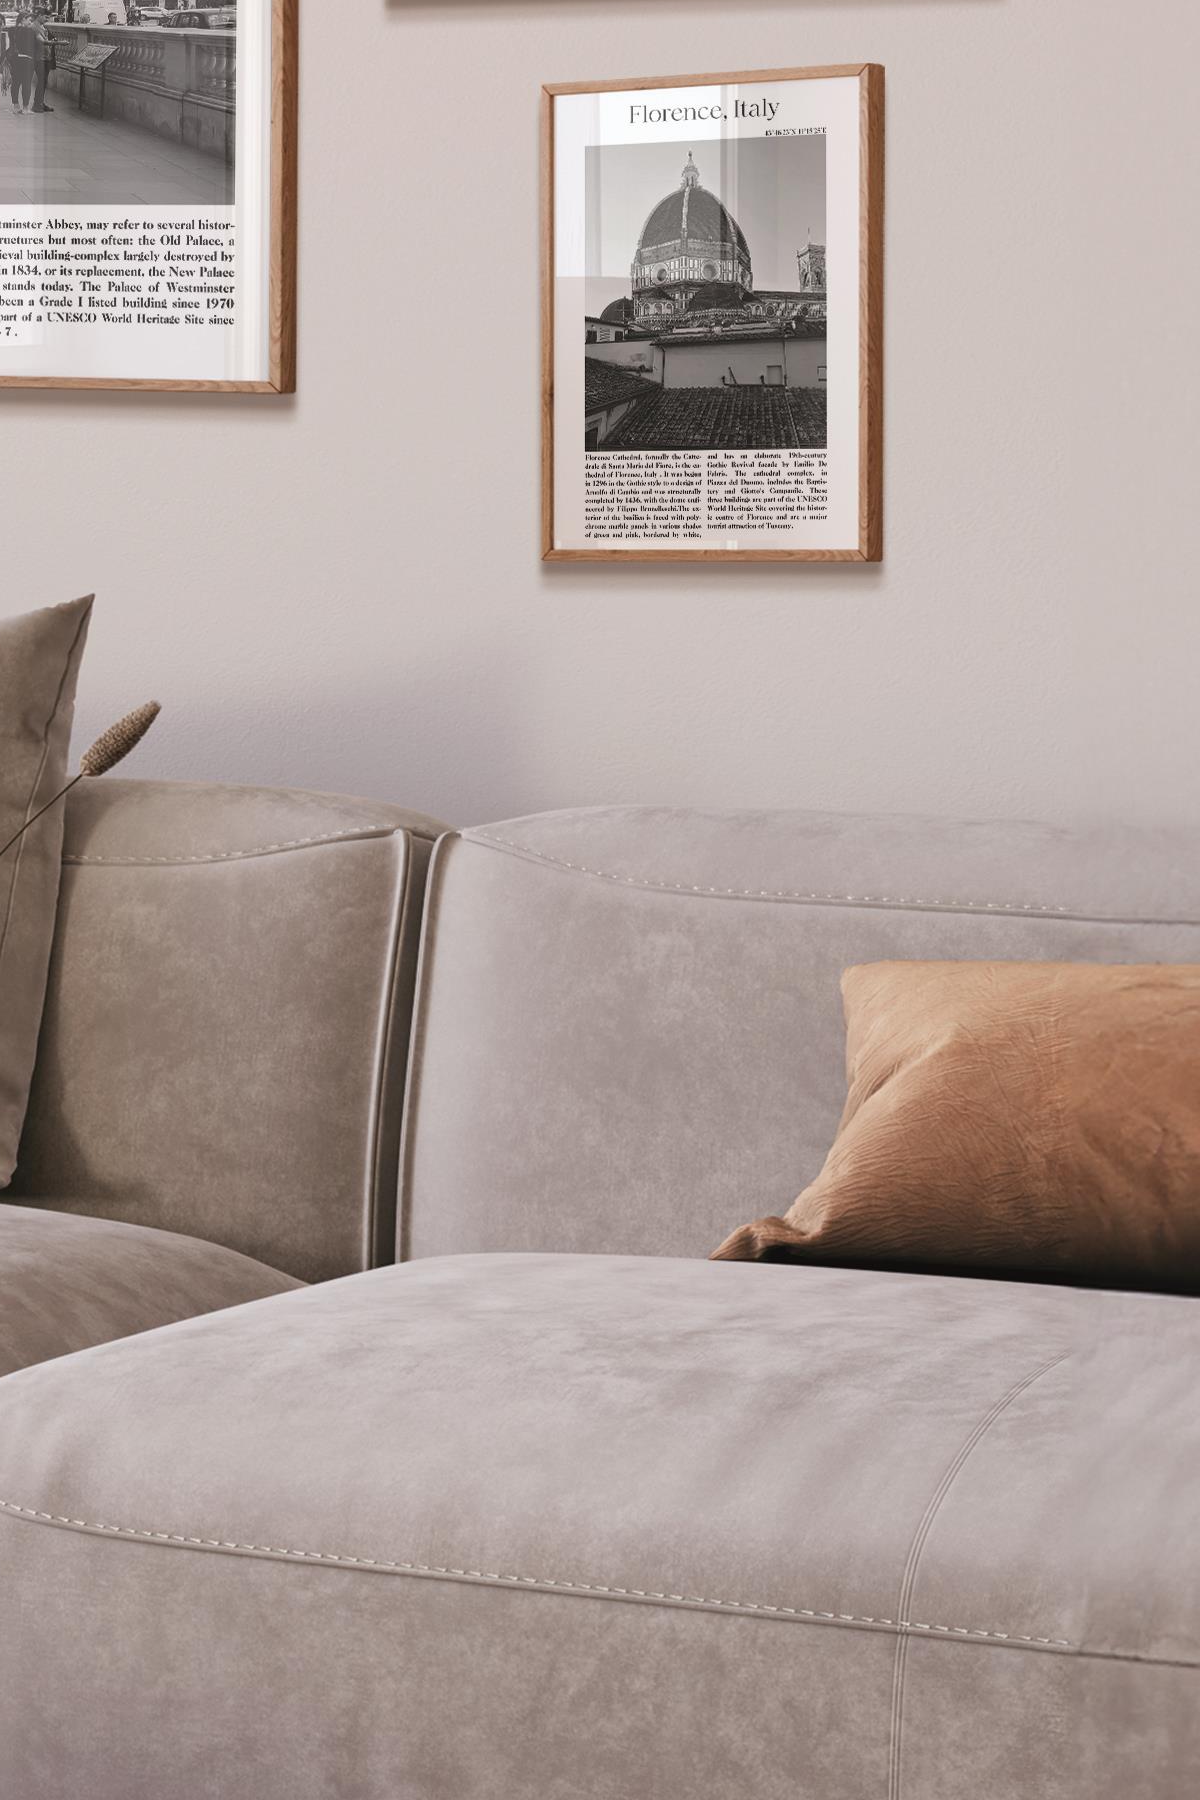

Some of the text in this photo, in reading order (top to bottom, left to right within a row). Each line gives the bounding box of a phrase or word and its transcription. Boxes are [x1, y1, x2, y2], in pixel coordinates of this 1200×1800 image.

[630, 98, 781, 124] Florence, Italy
[86, 222, 110, 231] may
[112, 218, 140, 230] refer
[142, 221, 154, 230] to
[157, 219, 195, 230] several
[198, 219, 235, 230] histor-
[48, 234, 66, 245] but
[71, 237, 96, 246] most
[101, 234, 133, 246] often:
[138, 234, 156, 246] the
[160, 234, 181, 246] Old
[228, 238, 235, 246] a
[27, 249, 120, 263] building-complex
[123, 250, 160, 263] largely
[163, 250, 218, 263] destroyed
[220, 251, 235, 263] by
[44, 268, 57, 276] or
[59, 265, 73, 277] its
[148, 266, 166, 278] the
[169, 266, 196, 278] New
[199, 266, 235, 278] Palace
[2, 280, 36, 291] stands
[79, 280, 101, 292] The
[108, 281, 142, 293] Palace
[148, 281, 160, 293] of
[166, 281, 235, 294] Westminster
[28, 299, 35, 307] a
[39, 295, 73, 308] Grade
[78, 296, 83, 308] I
[88, 296, 117, 308] listed
[122, 296, 168, 310] building
[172, 297, 200, 309] since
[206, 298, 235, 310] 1970
[21, 311, 33, 322] of
[47, 311, 97, 324] UNESCO
[102, 312, 132, 324] World
[137, 313, 180, 325] Heritage
[184, 314, 205, 325] Site
[208, 314, 235, 326] since
